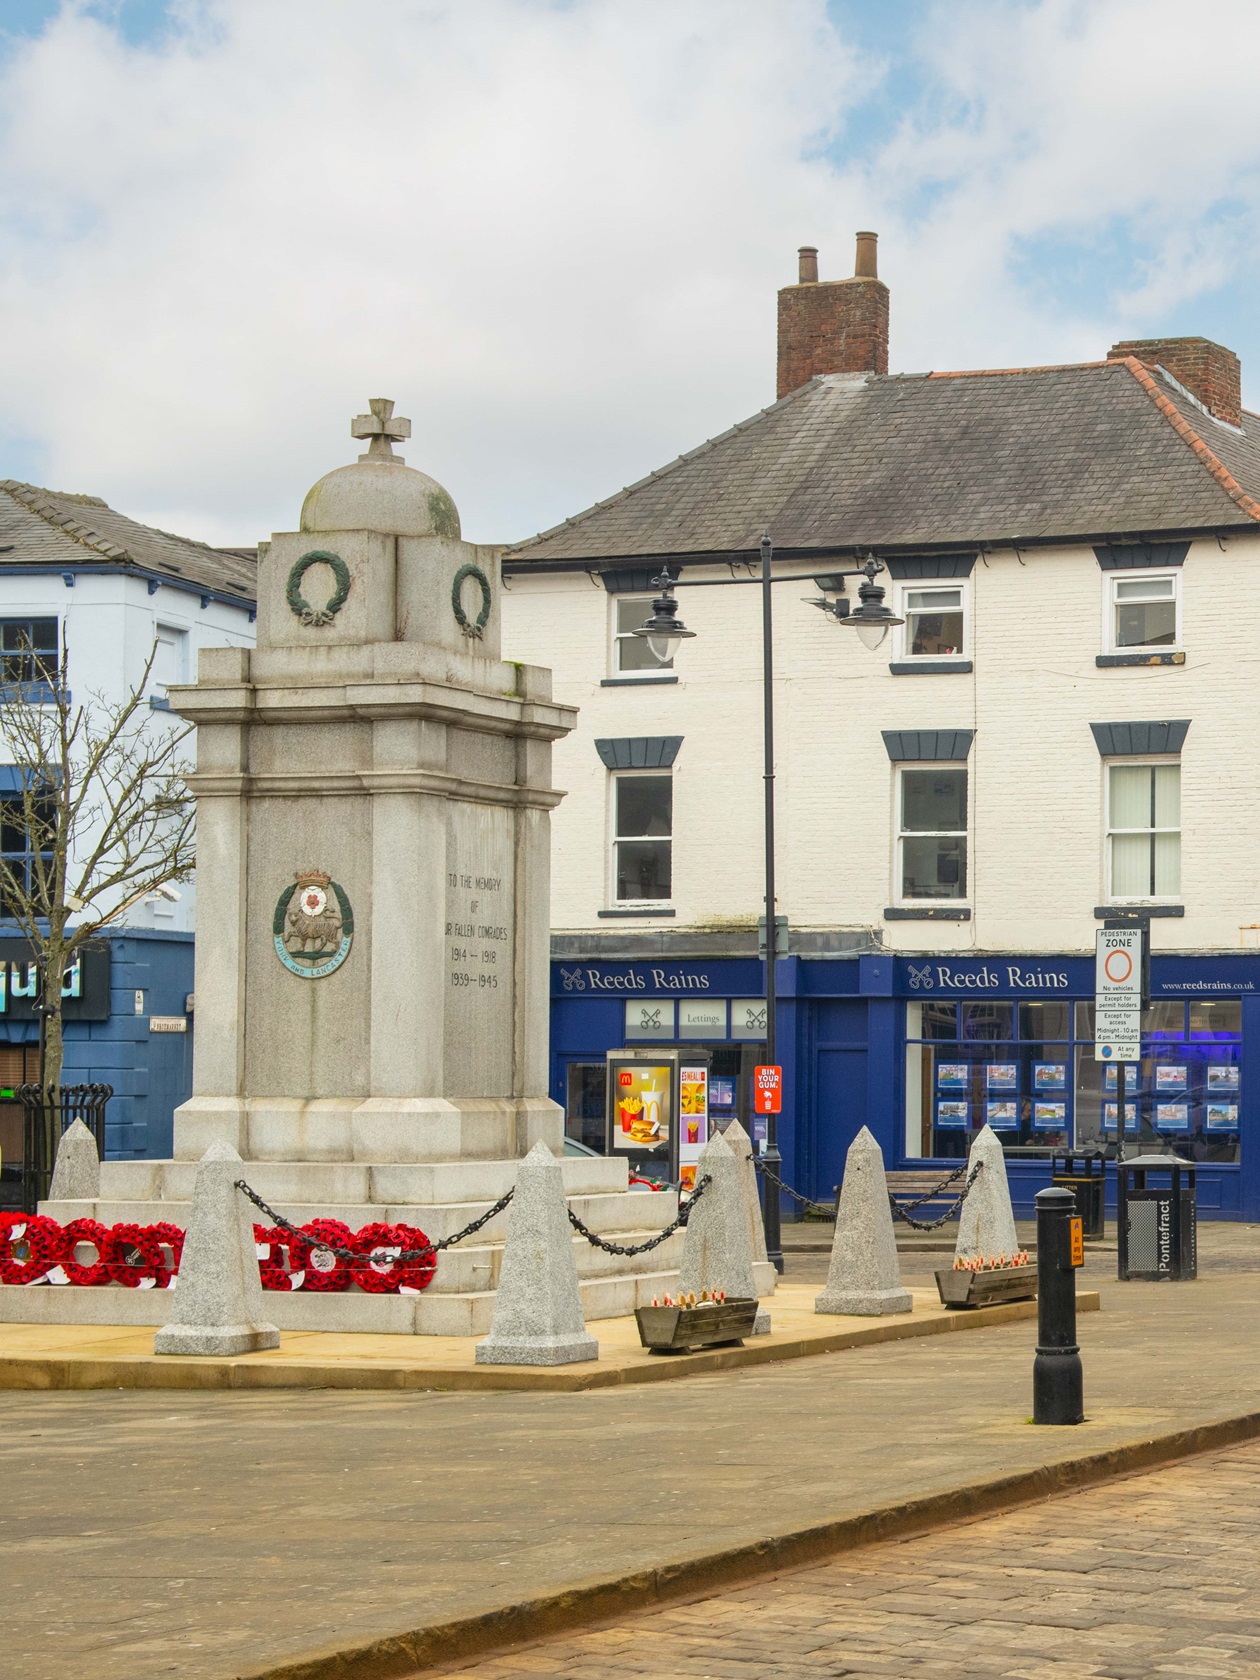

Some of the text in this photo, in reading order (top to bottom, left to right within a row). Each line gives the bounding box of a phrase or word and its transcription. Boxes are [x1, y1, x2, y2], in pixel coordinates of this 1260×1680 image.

[449, 873, 501, 891] TO THE MEMORY
[471, 900, 479, 914] OF
[454, 924, 475, 938] FALLEN
[478, 926, 508, 940] COMRADES
[1105, 939, 1132, 947] ZONE
[276, 939, 350, 976] YORK AND LANCASTER
[451, 947, 467, 961] 1914
[481, 951, 497, 964] 1918
[586, 969, 710, 989] Reeds Rains
[936, 967, 1069, 988] Reeds Rains
[1162, 980, 1255, 991] www.reedsrains.co.uk
[687, 1014, 720, 1025] Lettings
[1159, 1200, 1170, 1272] Pontefract
